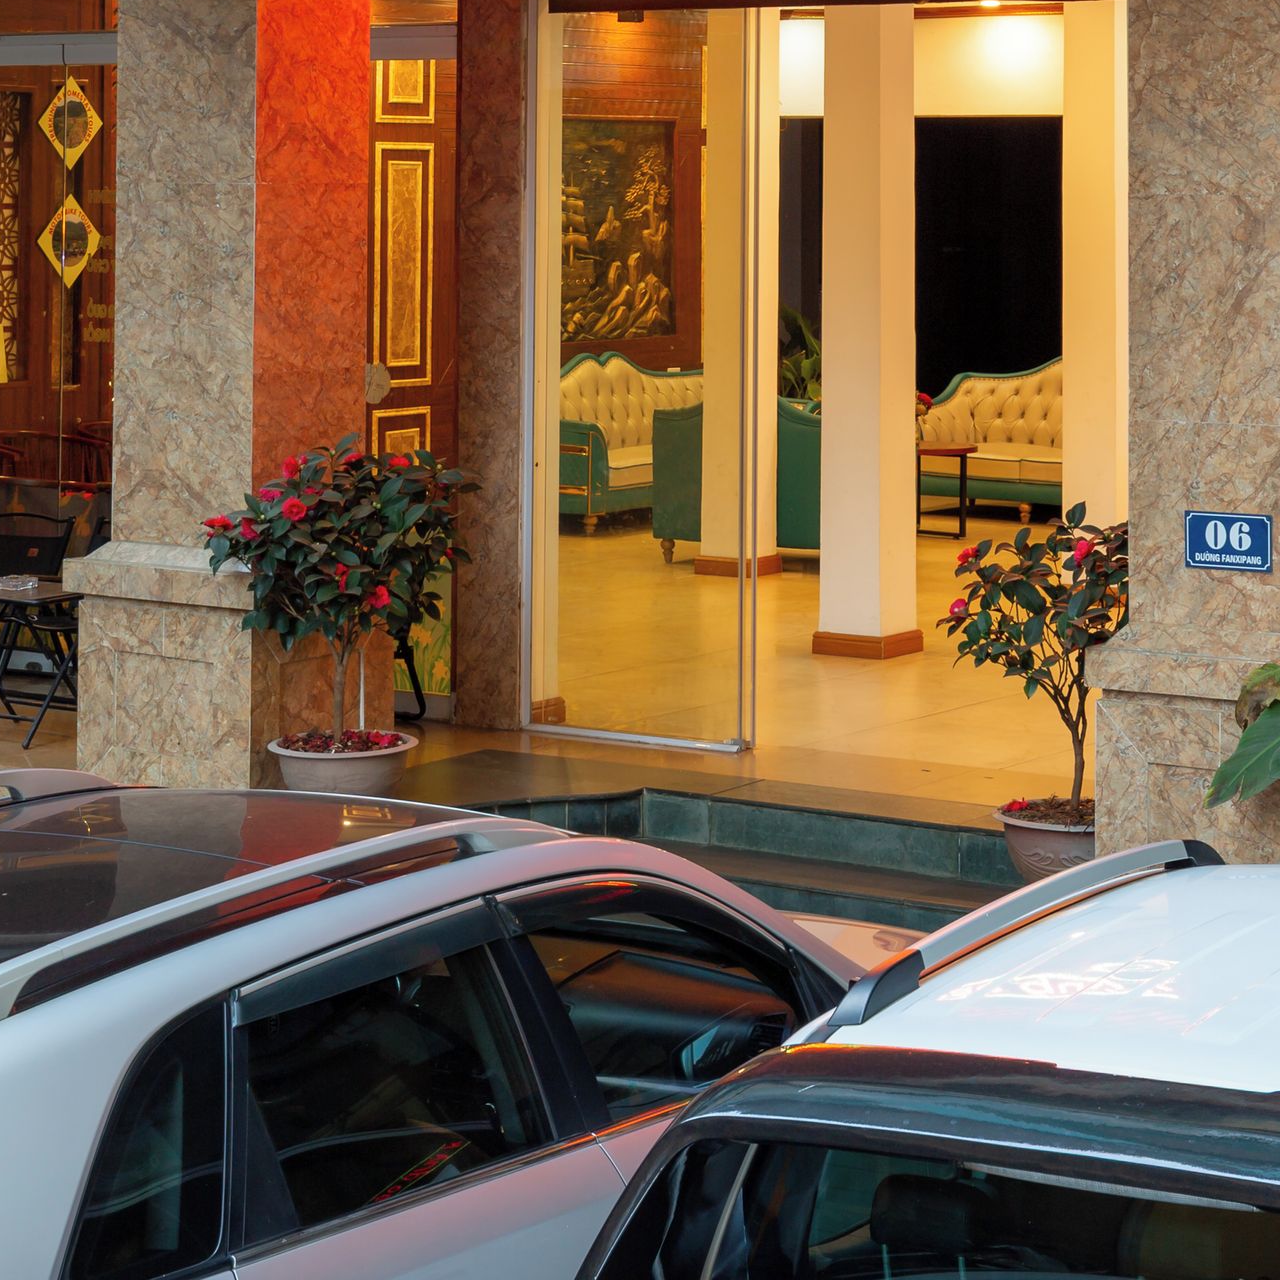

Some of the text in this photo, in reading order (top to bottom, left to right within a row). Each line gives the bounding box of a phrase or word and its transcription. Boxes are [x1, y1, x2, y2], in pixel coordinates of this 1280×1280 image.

[62, 89, 92, 112] OMESTAY
[1205, 520, 1252, 551] 06
[1221, 553, 1263, 566] FANXIPANG
